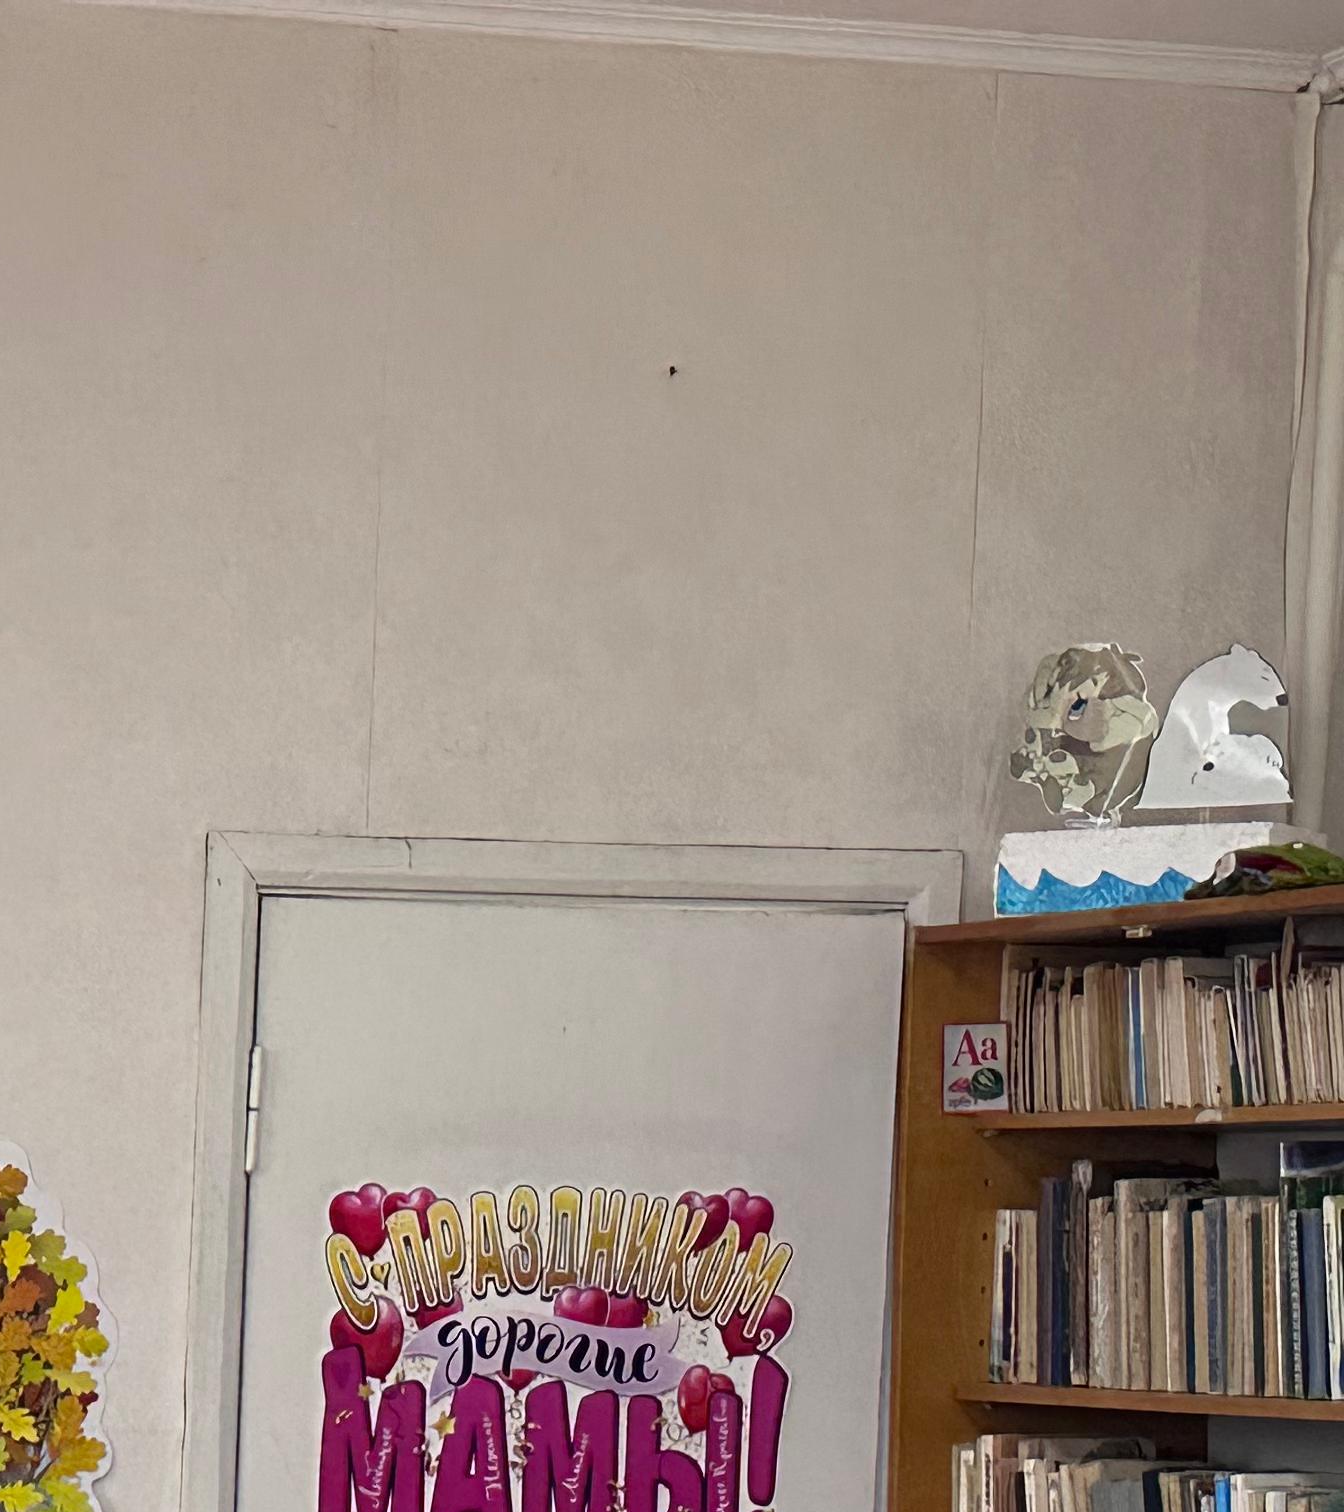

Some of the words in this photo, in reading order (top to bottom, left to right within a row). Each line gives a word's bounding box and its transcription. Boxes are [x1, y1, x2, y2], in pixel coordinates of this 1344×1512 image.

[325, 1232, 379, 1329] С
[385, 1185, 793, 1352] ПРАЗДНИКОМ,
[437, 1314, 659, 1386] дорогие
